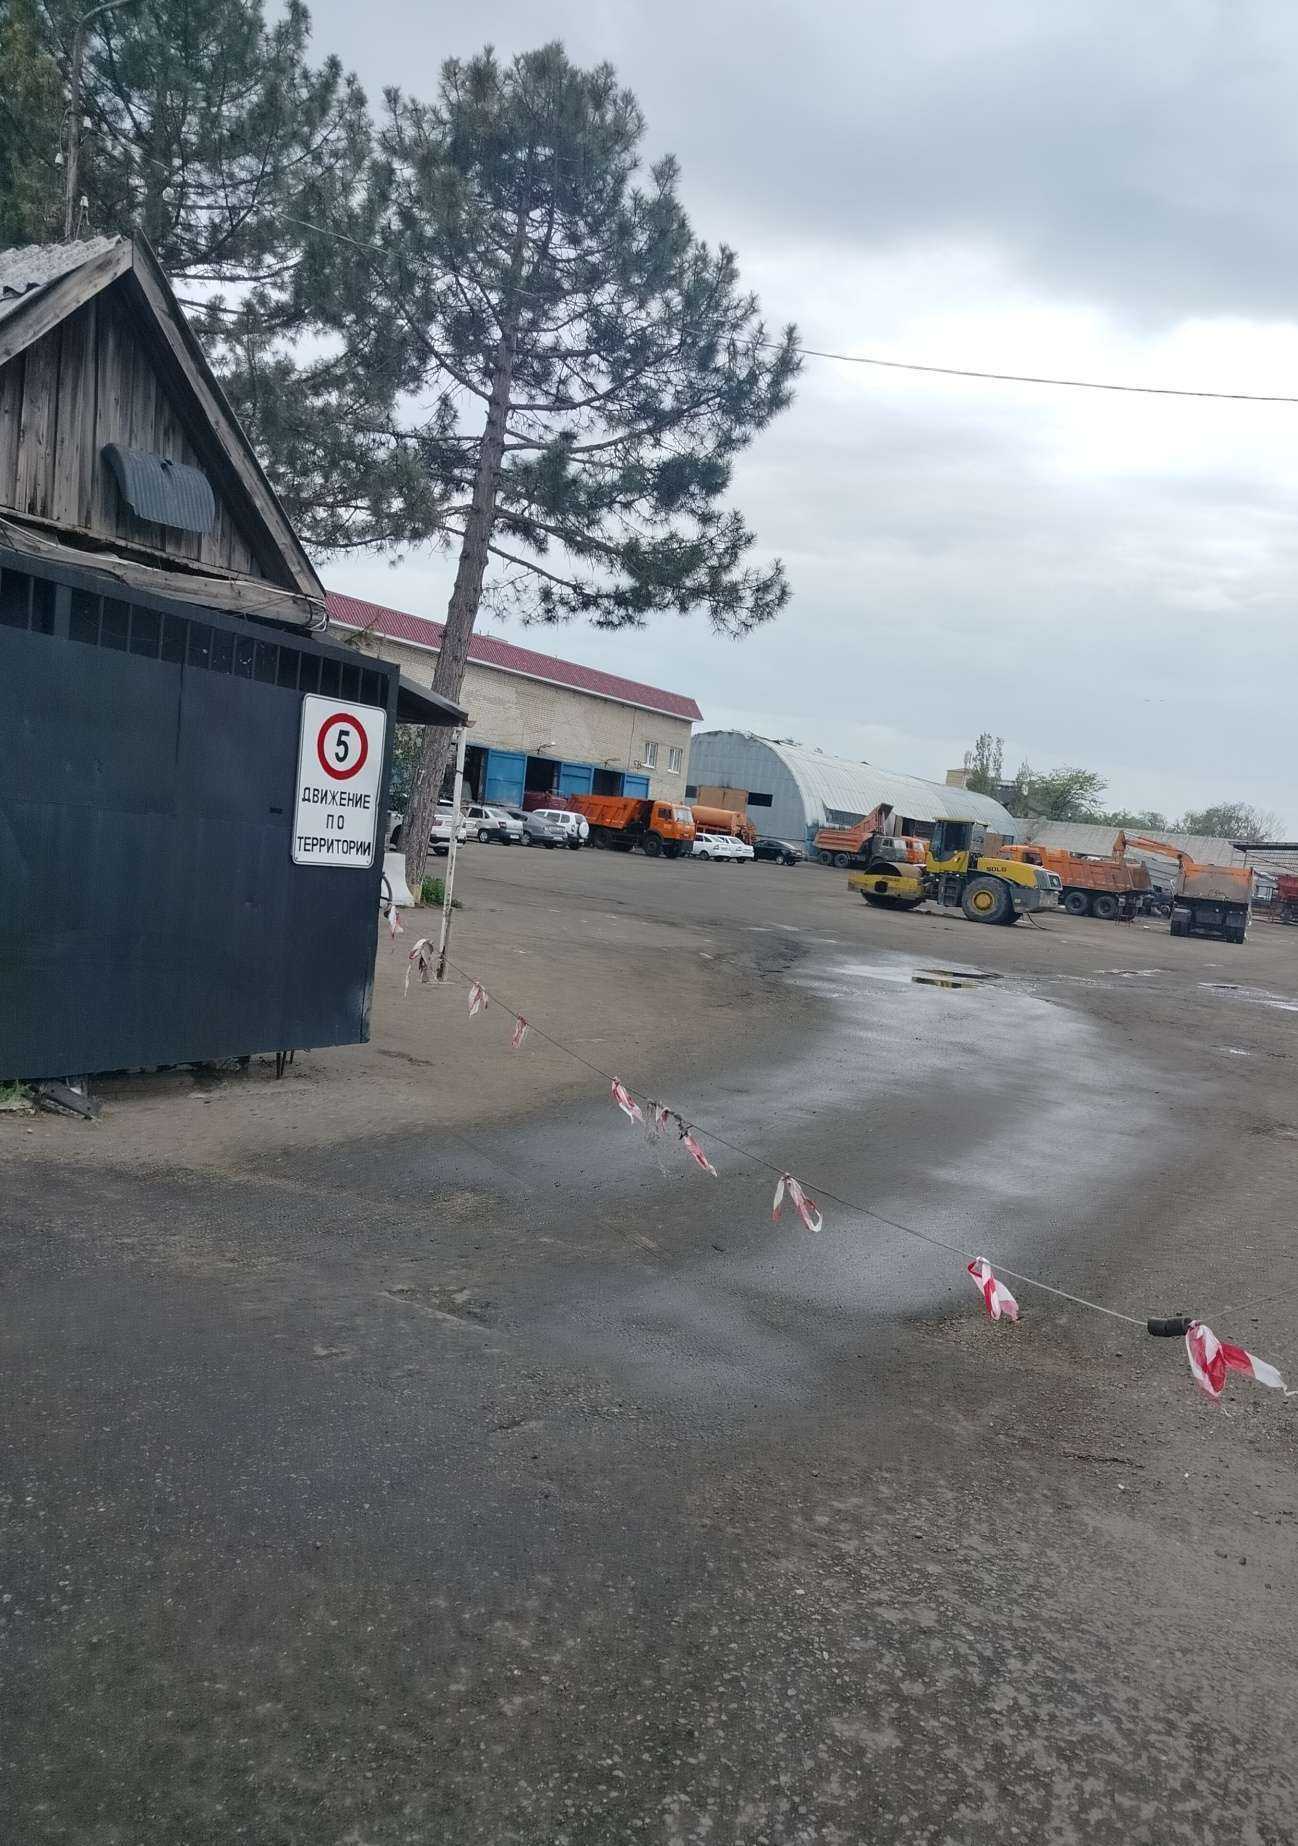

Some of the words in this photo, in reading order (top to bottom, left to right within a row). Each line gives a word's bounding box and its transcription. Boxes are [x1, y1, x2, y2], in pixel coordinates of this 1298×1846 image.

[335, 729, 350, 763] 5
[302, 787, 371, 809] ДВИЖЕНИЕ
[326, 814, 345, 830] ПО
[297, 836, 371, 856] ТЕРРИТОРИИ
